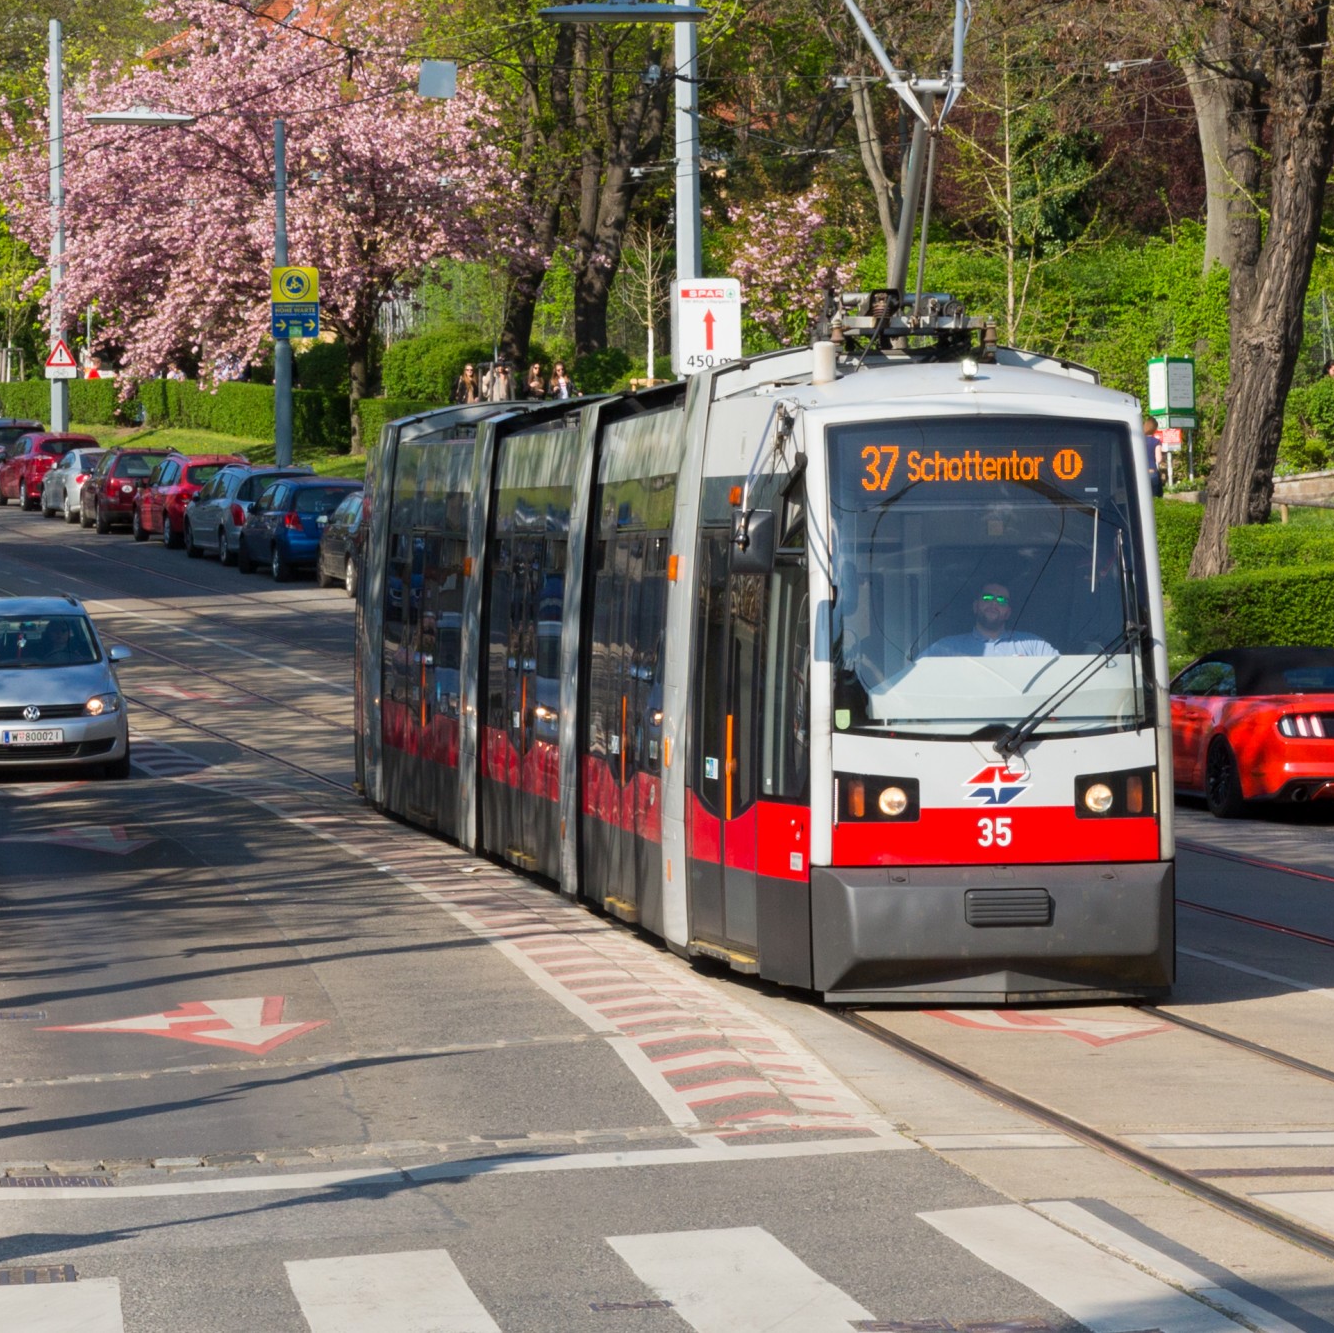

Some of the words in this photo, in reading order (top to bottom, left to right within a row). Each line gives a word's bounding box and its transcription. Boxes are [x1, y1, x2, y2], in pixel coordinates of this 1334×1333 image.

[688, 289, 724, 298] SPAR
[687, 354, 714, 368] 450
[861, 445, 900, 492] 37
[907, 449, 1044, 482] Schottentor
[977, 817, 1012, 847] 35
